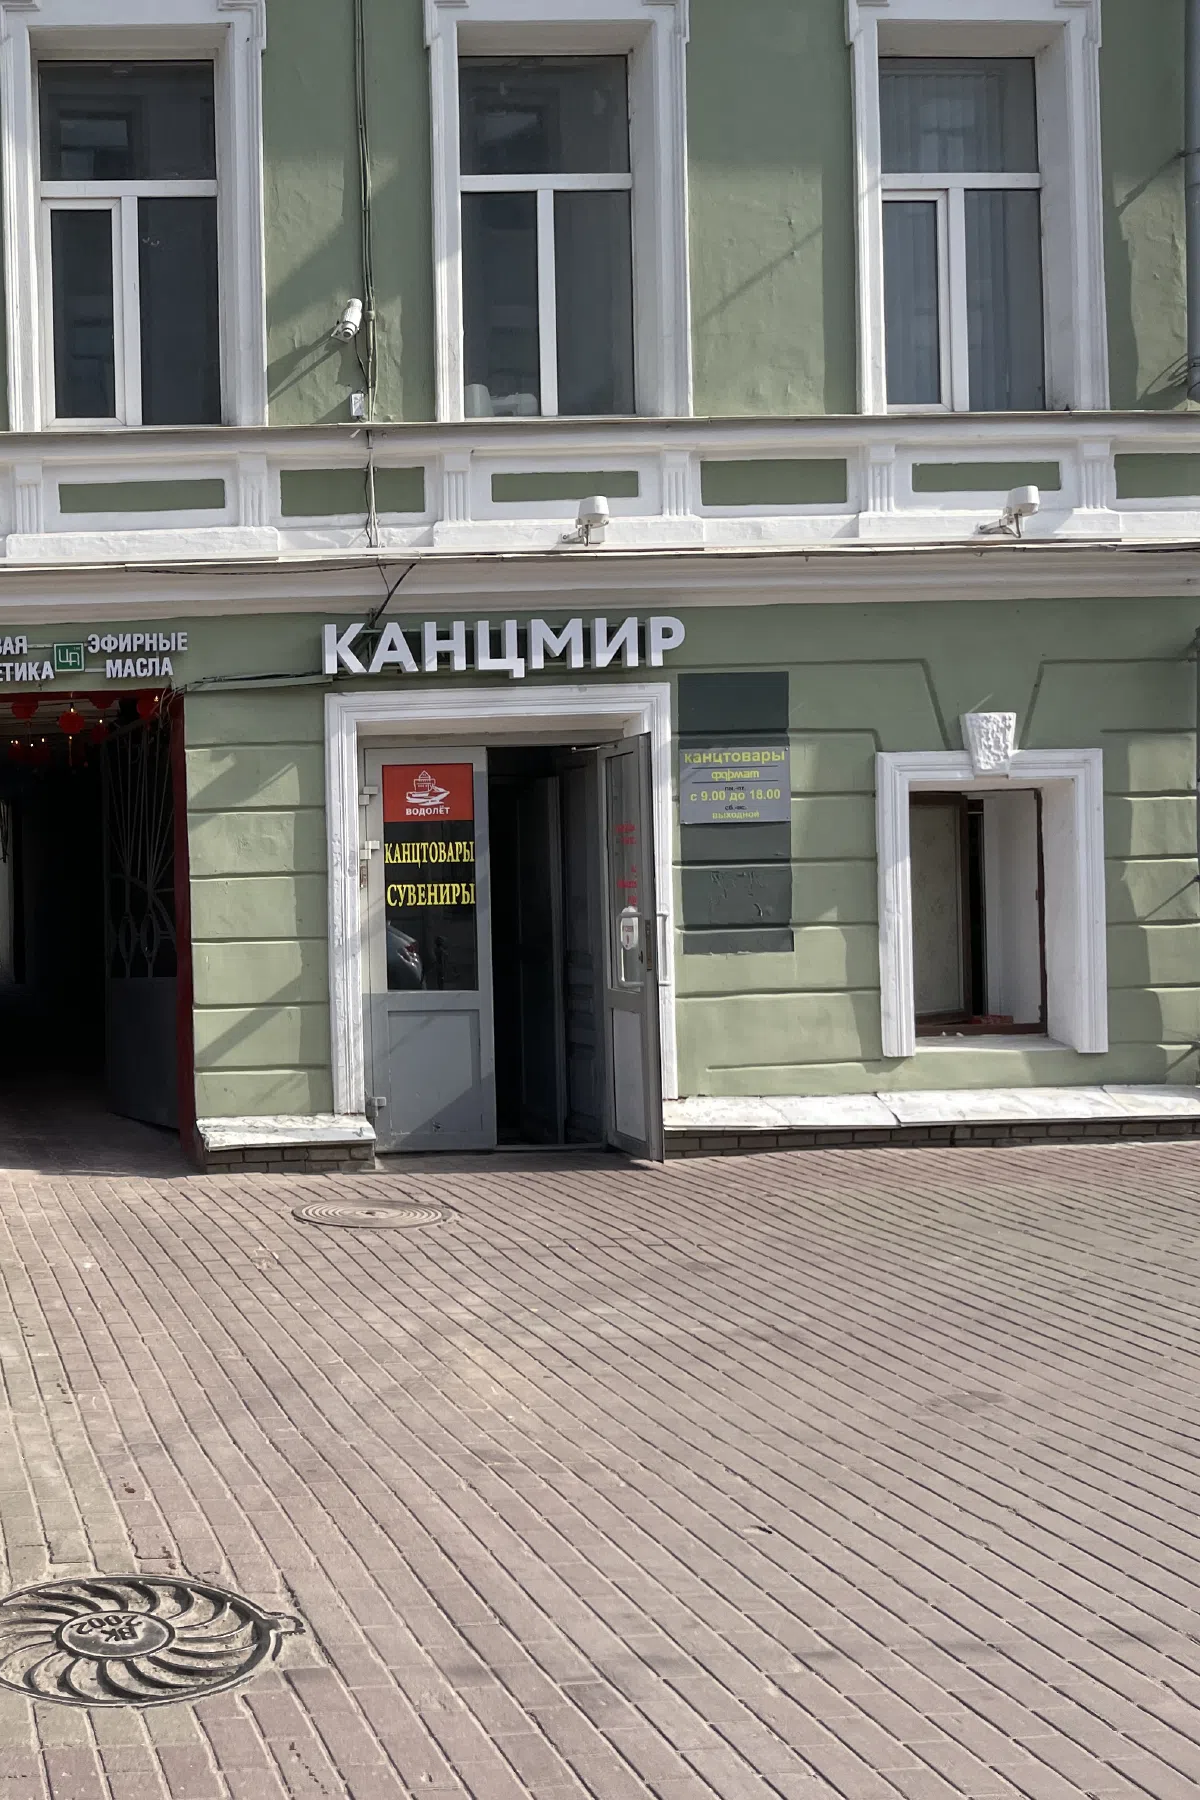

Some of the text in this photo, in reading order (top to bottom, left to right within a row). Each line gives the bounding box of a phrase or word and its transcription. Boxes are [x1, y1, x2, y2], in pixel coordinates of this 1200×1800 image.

[87, 632, 188, 653] ЭФИРНЫЕ
[322, 616, 686, 678] КАНЦМИР
[105, 657, 173, 679] МАСЛА
[684, 751, 785, 764] канцтовары
[690, 788, 781, 802] с 9.00 до 18.00
[405, 805, 450, 816] ВОДОЛЁТ
[384, 841, 475, 868] КАНЦТОВАРЫ
[386, 882, 476, 907] СУВЕНИРЫ
[70, 1615, 142, 1635] 2002
